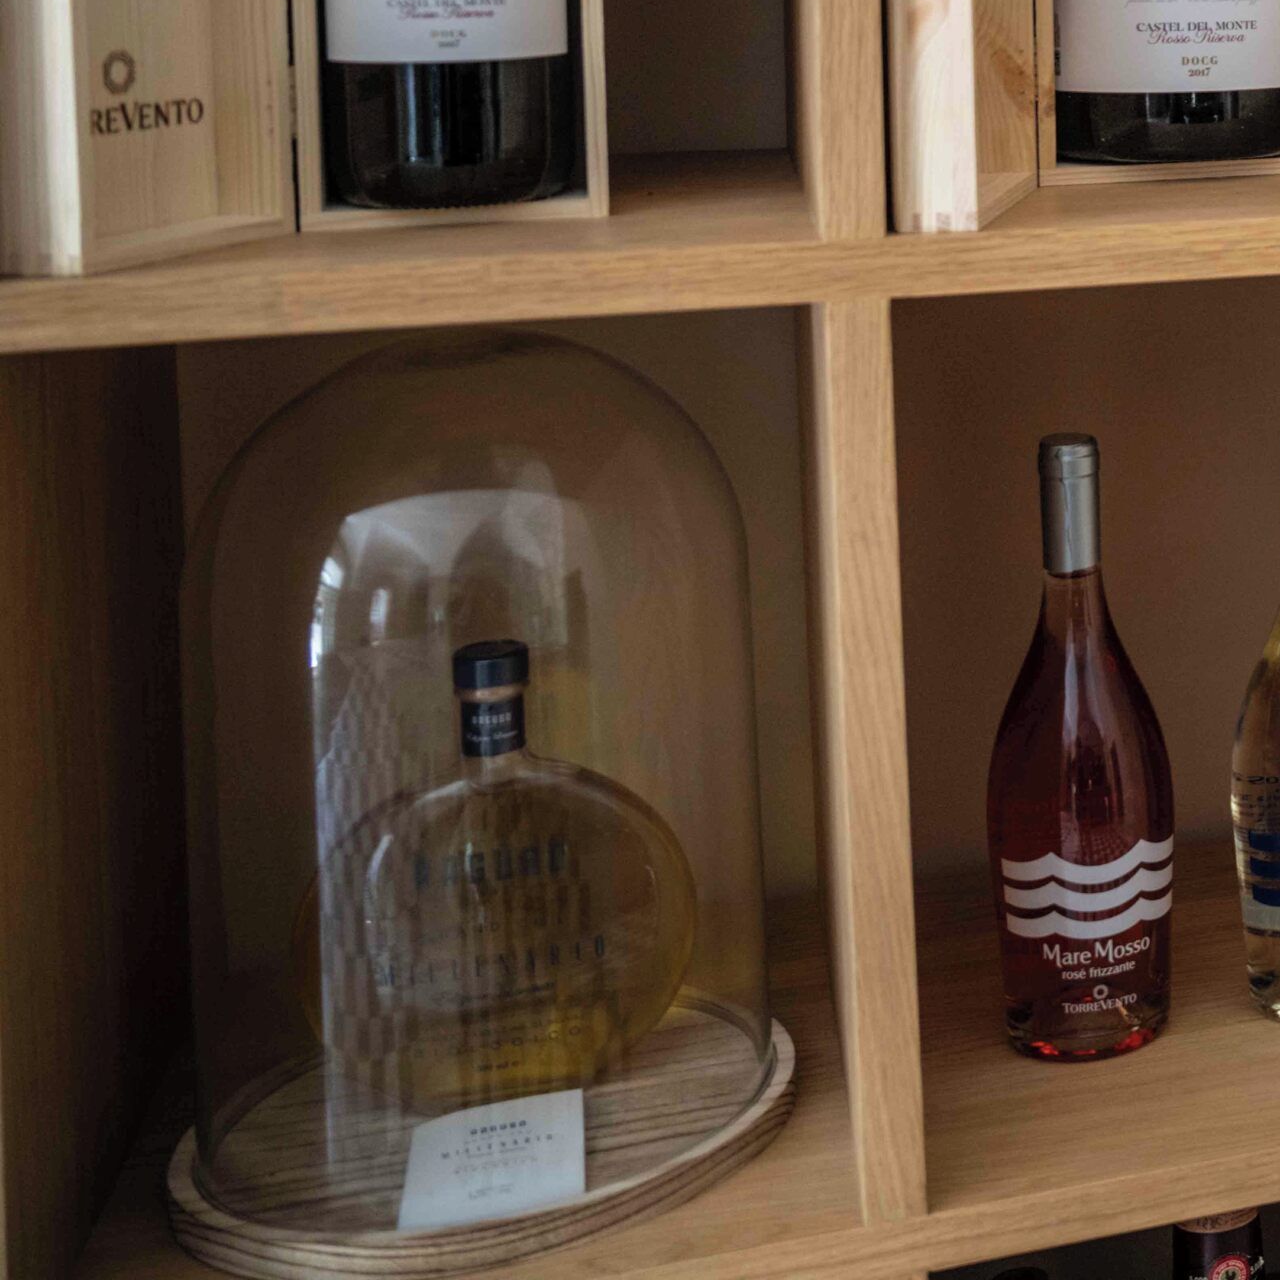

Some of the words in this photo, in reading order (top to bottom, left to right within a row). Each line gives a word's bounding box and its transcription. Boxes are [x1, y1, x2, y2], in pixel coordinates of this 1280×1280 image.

[1136, 21, 1184, 32] CASTEL
[1187, 21, 1213, 32] DEL
[1216, 20, 1257, 31] MONTE
[90, 97, 204, 135] REVENTO
[1043, 943, 1092, 968] Mare
[1095, 937, 1150, 963] Mosso
[1062, 970, 1087, 979] rosé
[1089, 960, 1136, 978] frizzante
